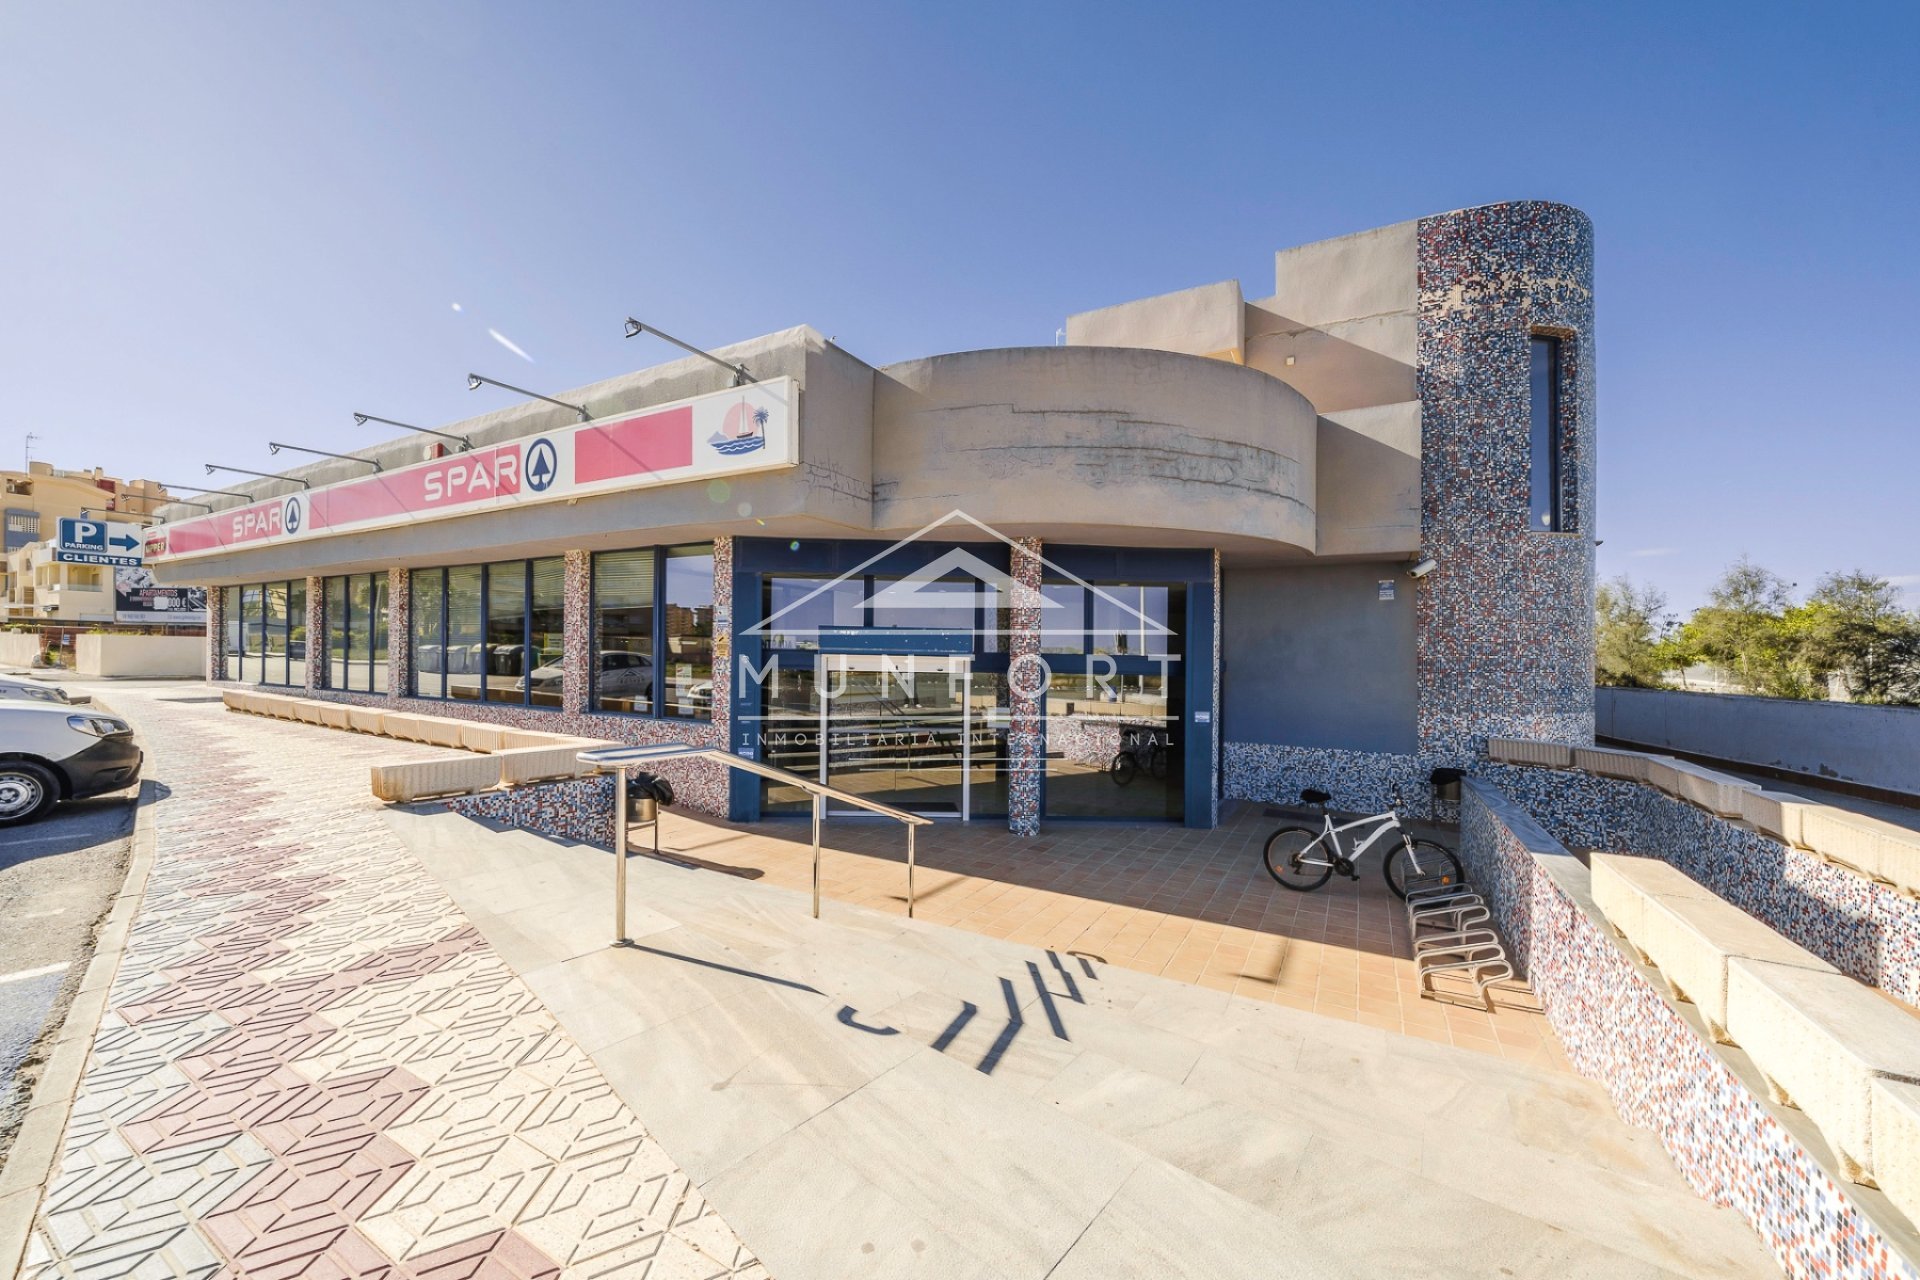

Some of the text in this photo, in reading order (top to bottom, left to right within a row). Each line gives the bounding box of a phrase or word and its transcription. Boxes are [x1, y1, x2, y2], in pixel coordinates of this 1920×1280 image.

[423, 452, 520, 503] SPAR
[74, 522, 98, 543] P
[232, 507, 281, 539] SPAR
[64, 542, 104, 551] PARKING
[63, 553, 138, 566] CLIENTES
